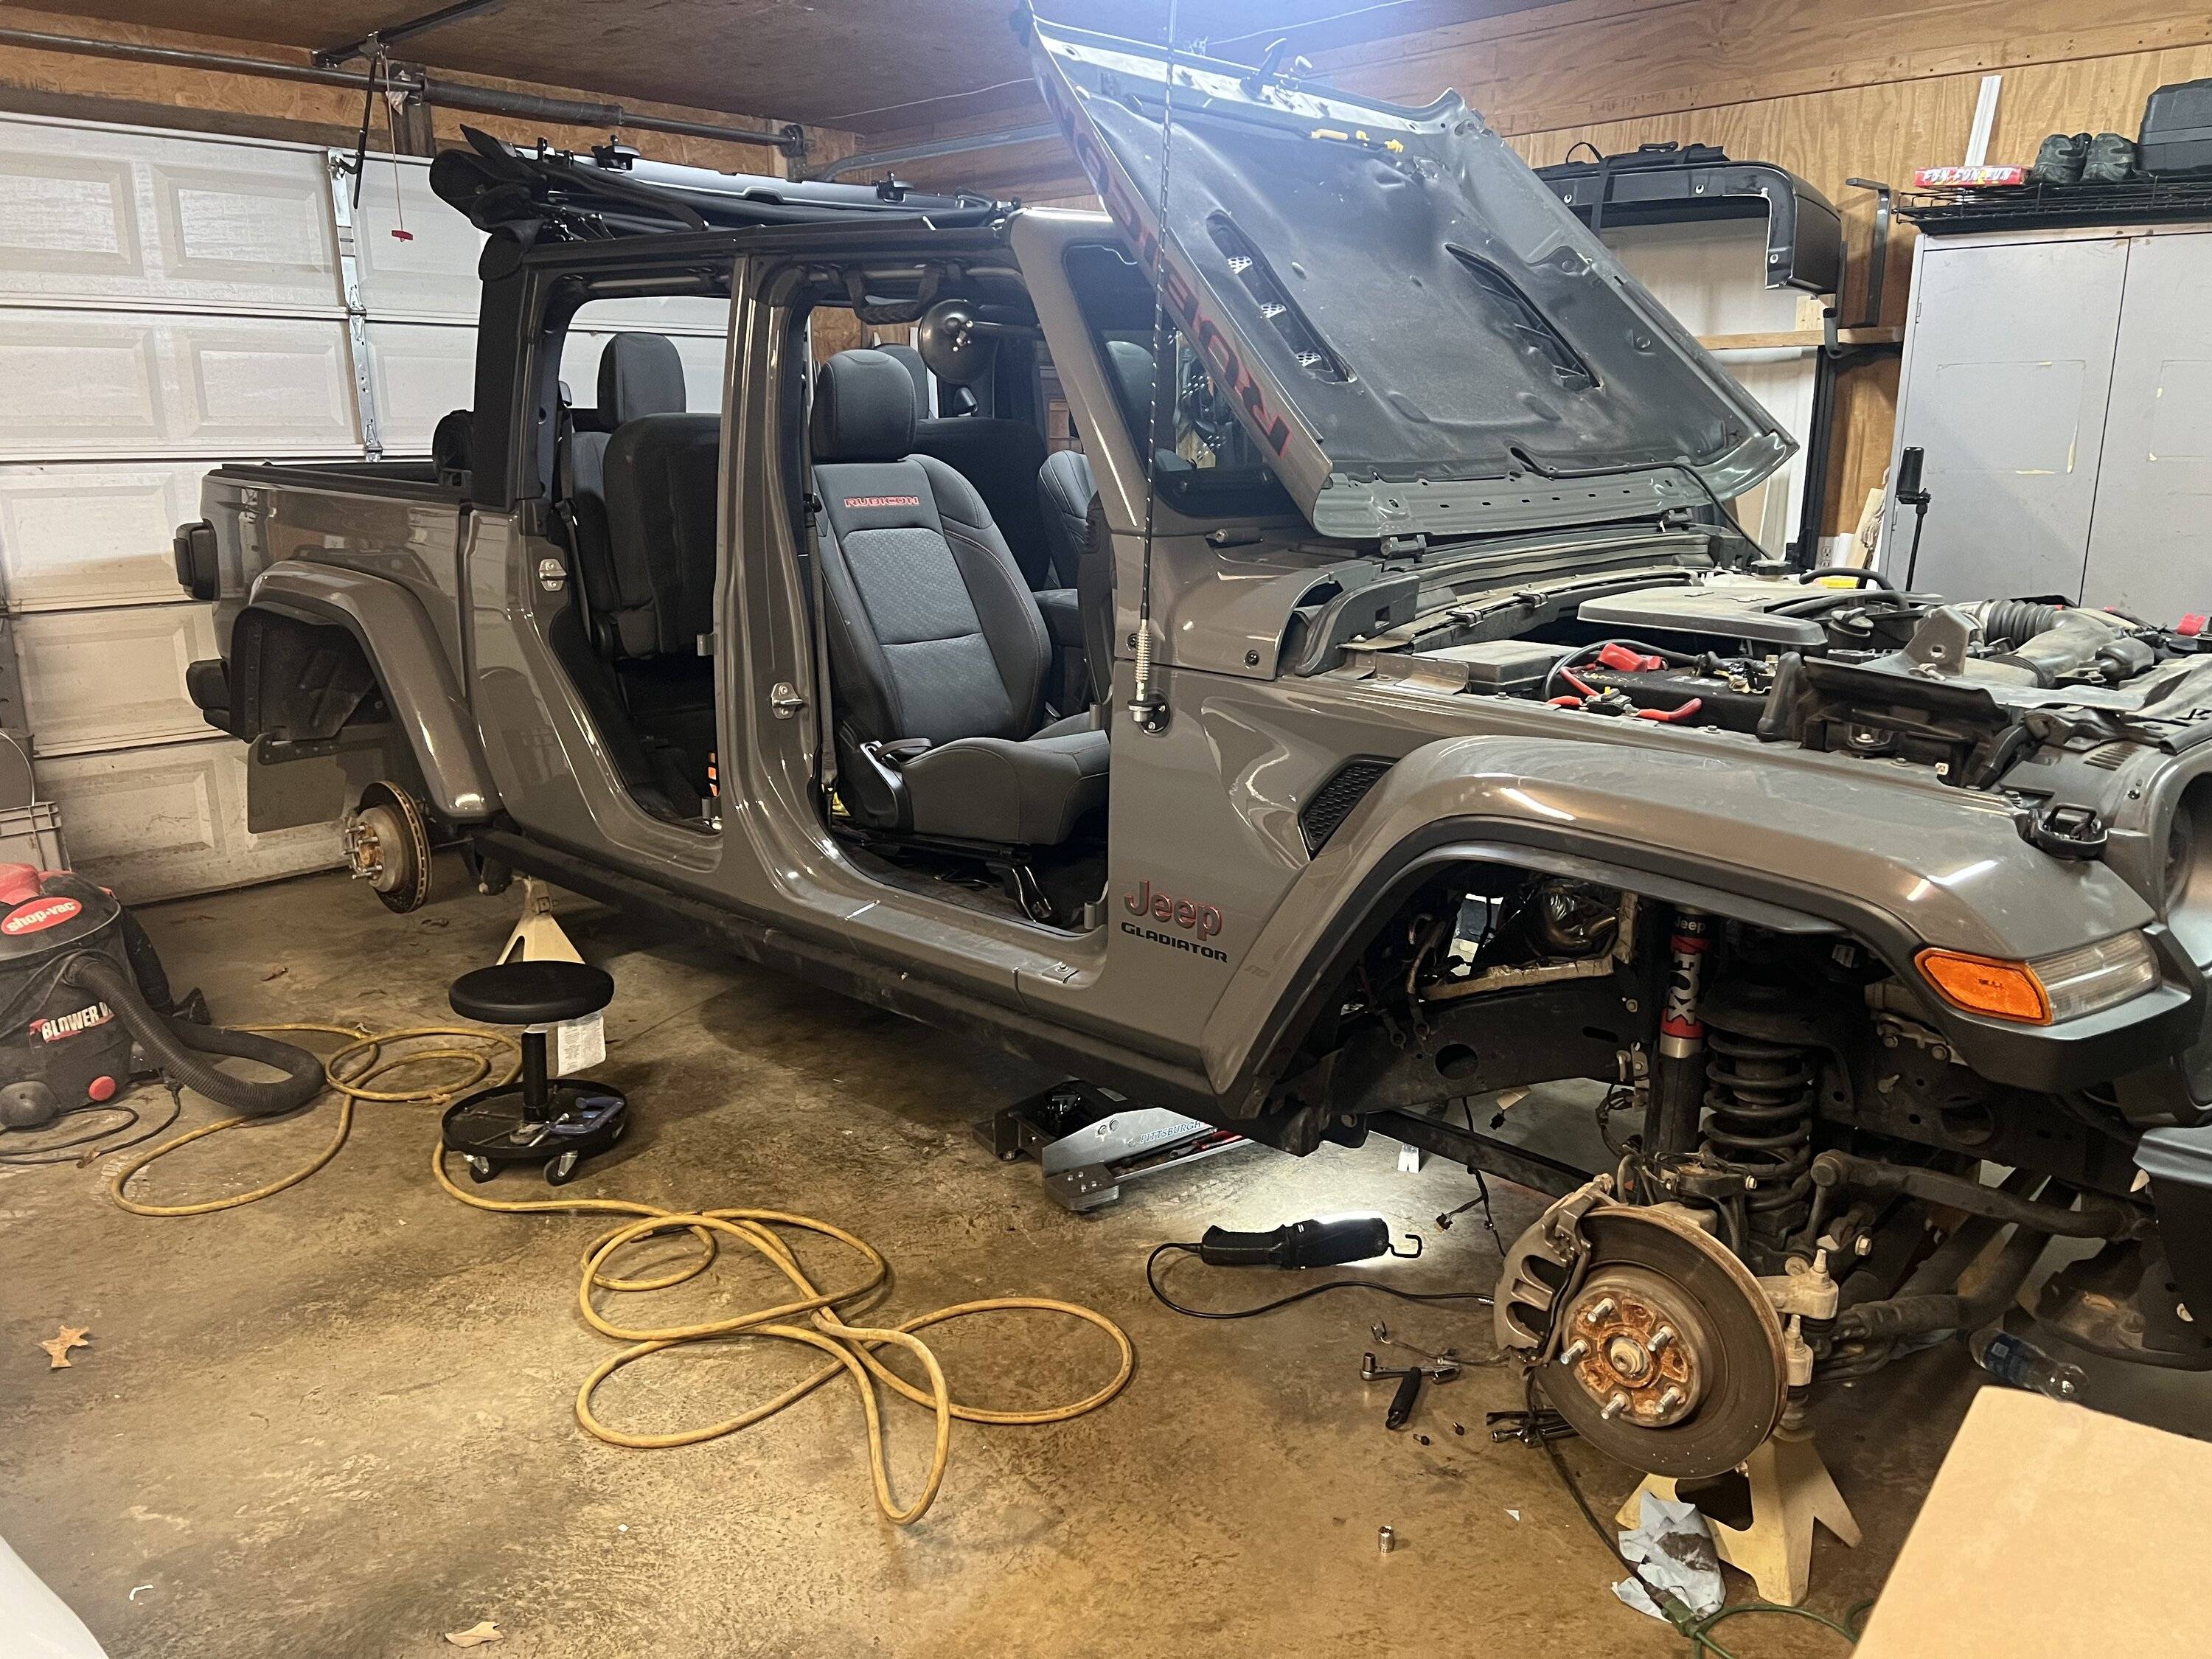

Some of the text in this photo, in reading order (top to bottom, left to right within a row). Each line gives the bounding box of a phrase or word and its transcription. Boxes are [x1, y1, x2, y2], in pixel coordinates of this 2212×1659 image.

[844, 496, 920, 507] RUBICON
[1124, 879, 1223, 941] Jeep
[1674, 916, 1706, 933] Jeep
[1121, 922, 1228, 963] GLADIATOR
[1666, 949, 1703, 1025] FOX
[41, 1005, 100, 1040] BLOWER
[1139, 1120, 1201, 1144] PITTSBURGH
